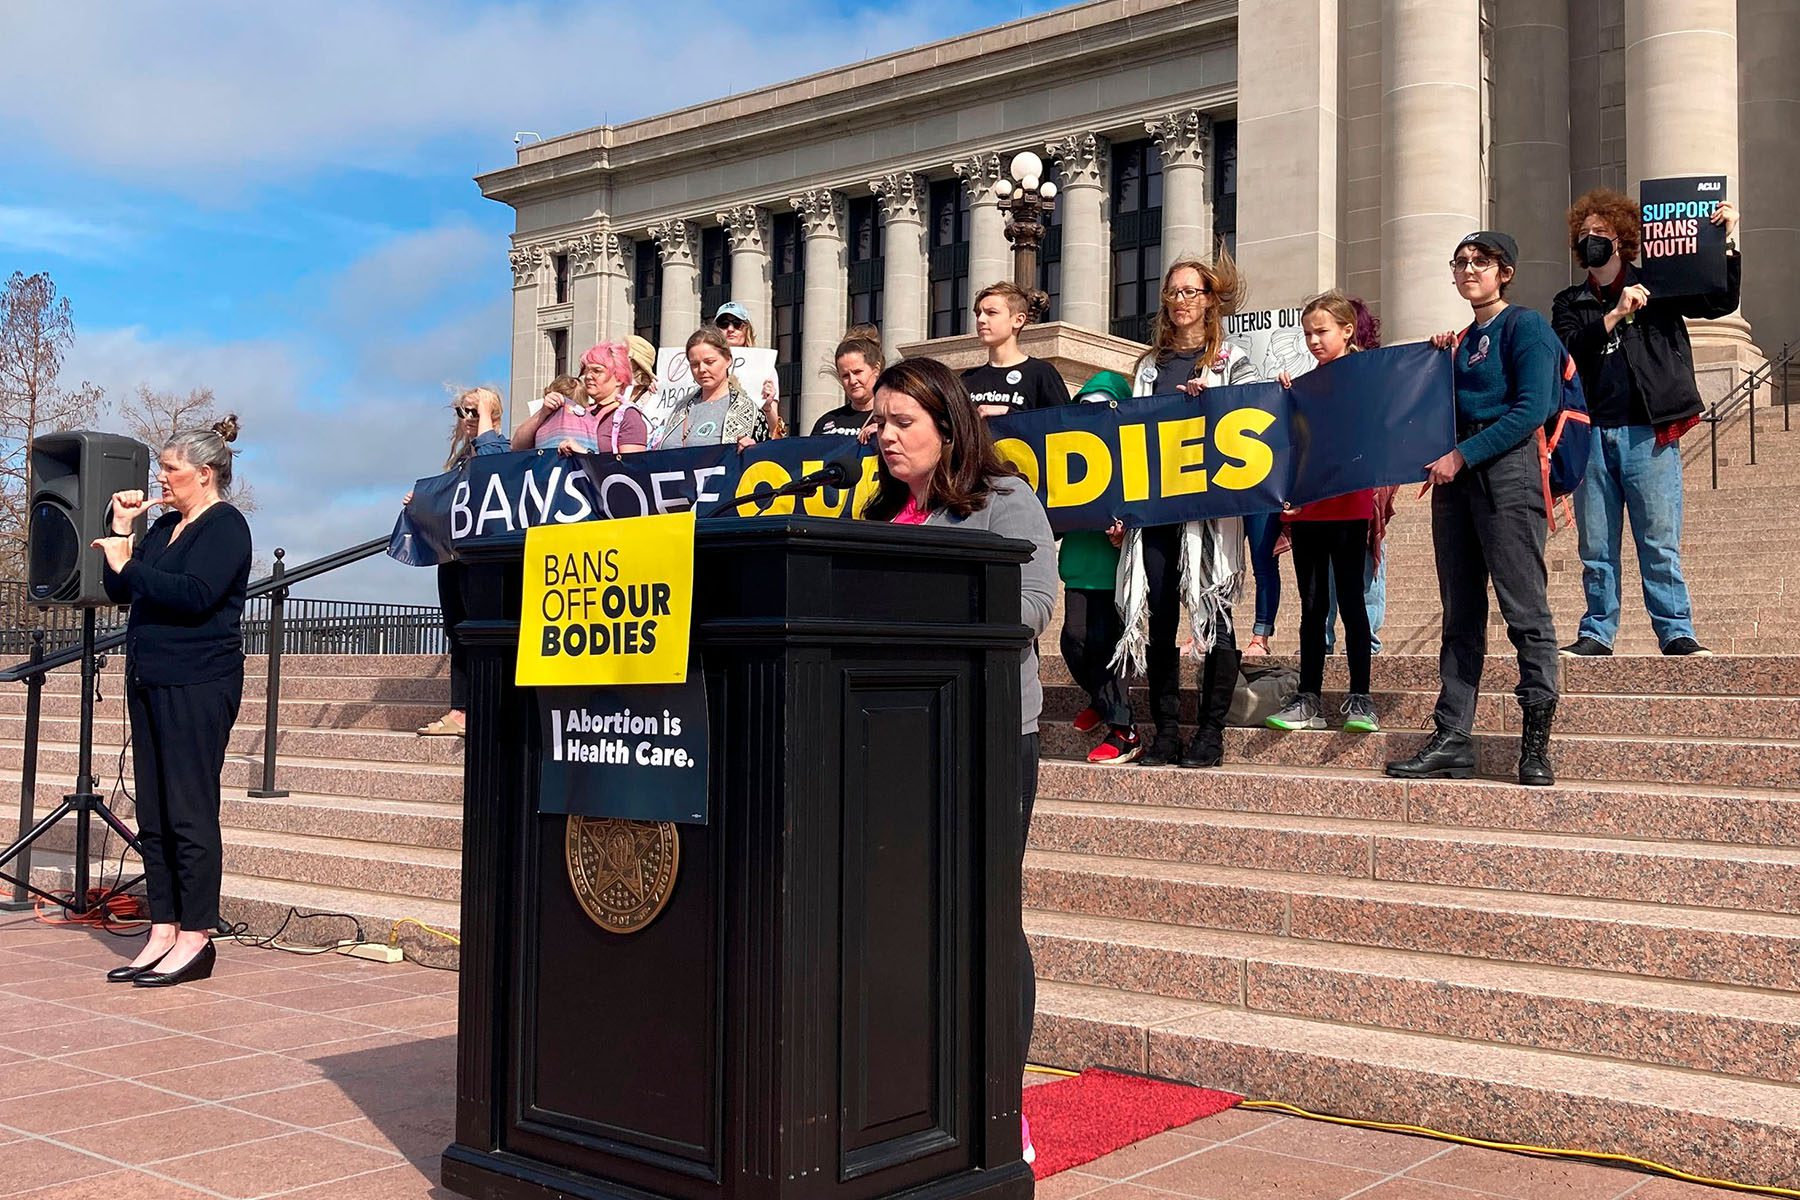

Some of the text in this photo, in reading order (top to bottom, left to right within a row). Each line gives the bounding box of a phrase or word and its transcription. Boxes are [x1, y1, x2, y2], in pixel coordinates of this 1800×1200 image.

[1697, 182, 1721, 191] ACLU
[1643, 200, 1719, 222] SUPPORT
[1643, 219, 1698, 240] TRANS
[1643, 237, 1697, 259] YOUTH
[1228, 310, 1272, 334] UTERUS
[970, 390, 1025, 405] bortion is
[451, 466, 593, 540] BANS
[600, 465, 726, 519] OFF
[994, 407, 1277, 508] ODIES
[544, 548, 619, 586] BANS
[542, 582, 671, 622] OFF OUR
[540, 619, 658, 657] BODIES
[566, 708, 682, 736] Abortion is
[567, 739, 695, 768] Health Care.
[608, 914, 630, 925] 1907
